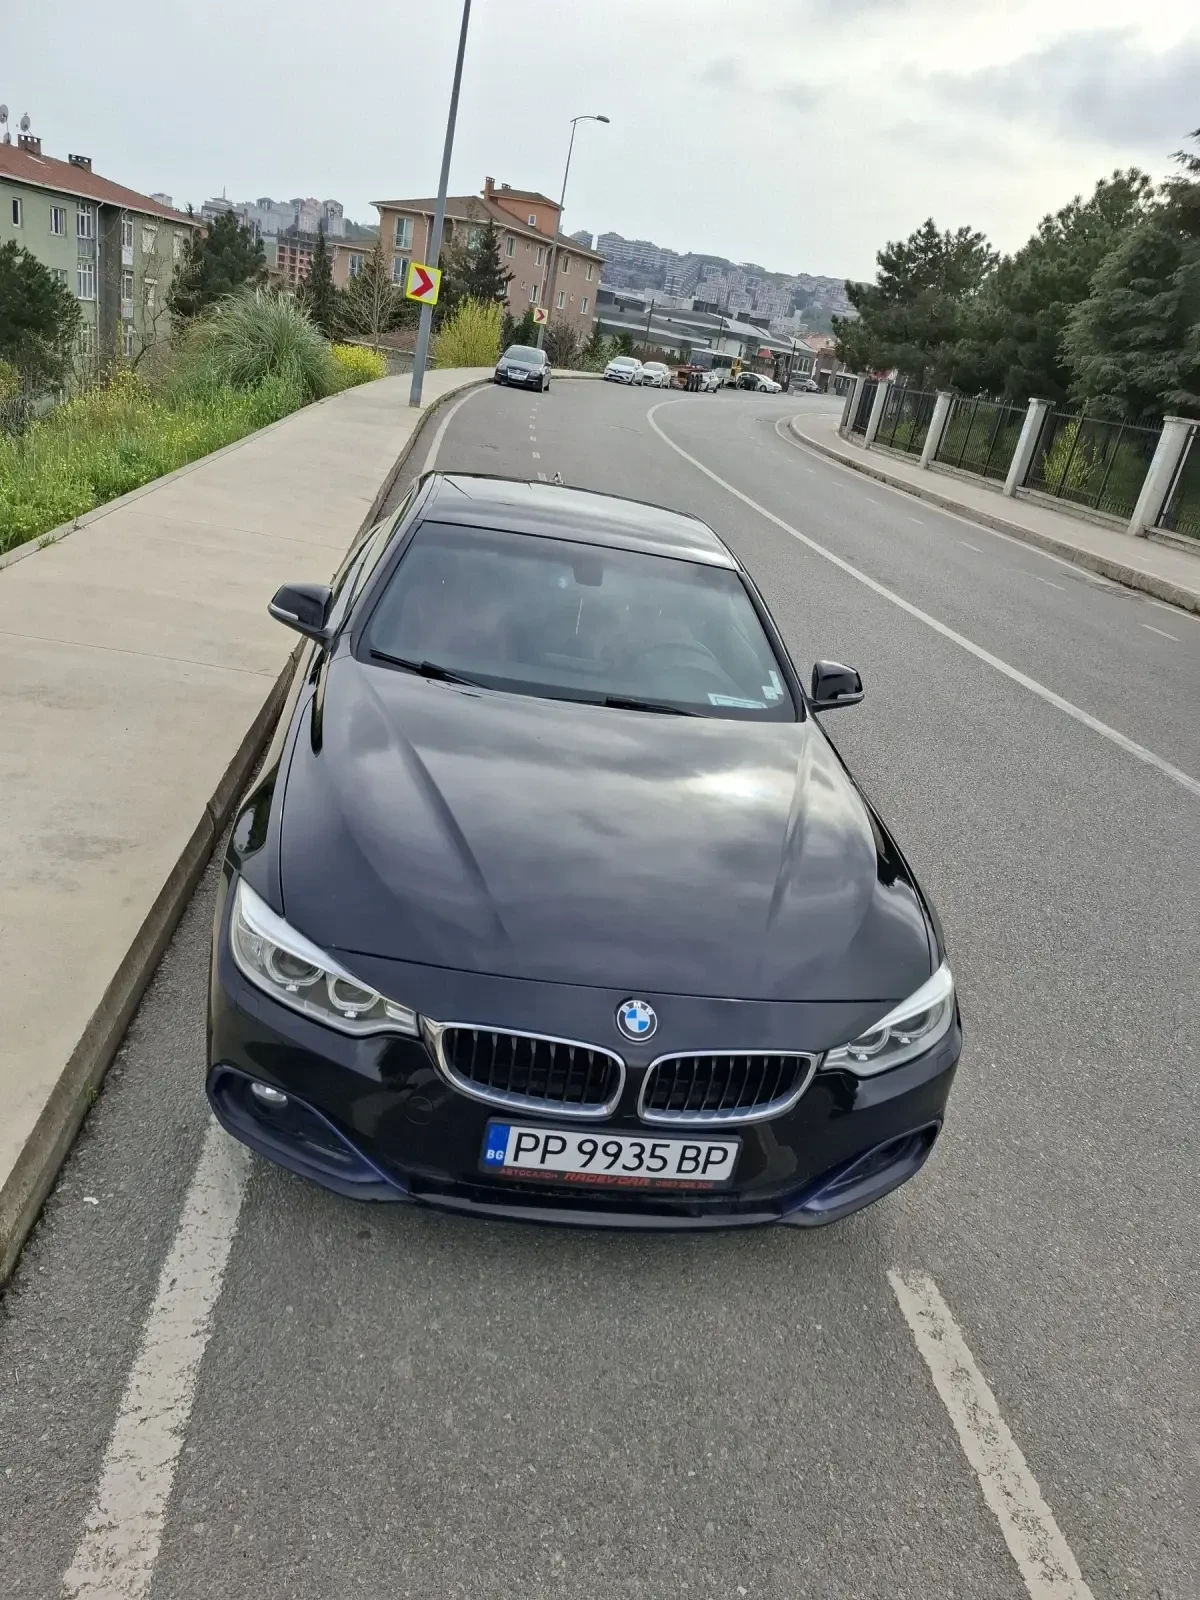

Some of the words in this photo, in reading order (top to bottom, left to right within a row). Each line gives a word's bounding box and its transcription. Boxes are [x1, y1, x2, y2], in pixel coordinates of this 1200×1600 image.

[621, 1002, 654, 1015] BMW
[486, 1149, 504, 1160] BG
[513, 1133, 567, 1164] PP
[577, 1138, 670, 1172] 9935
[676, 1144, 729, 1175] BP
